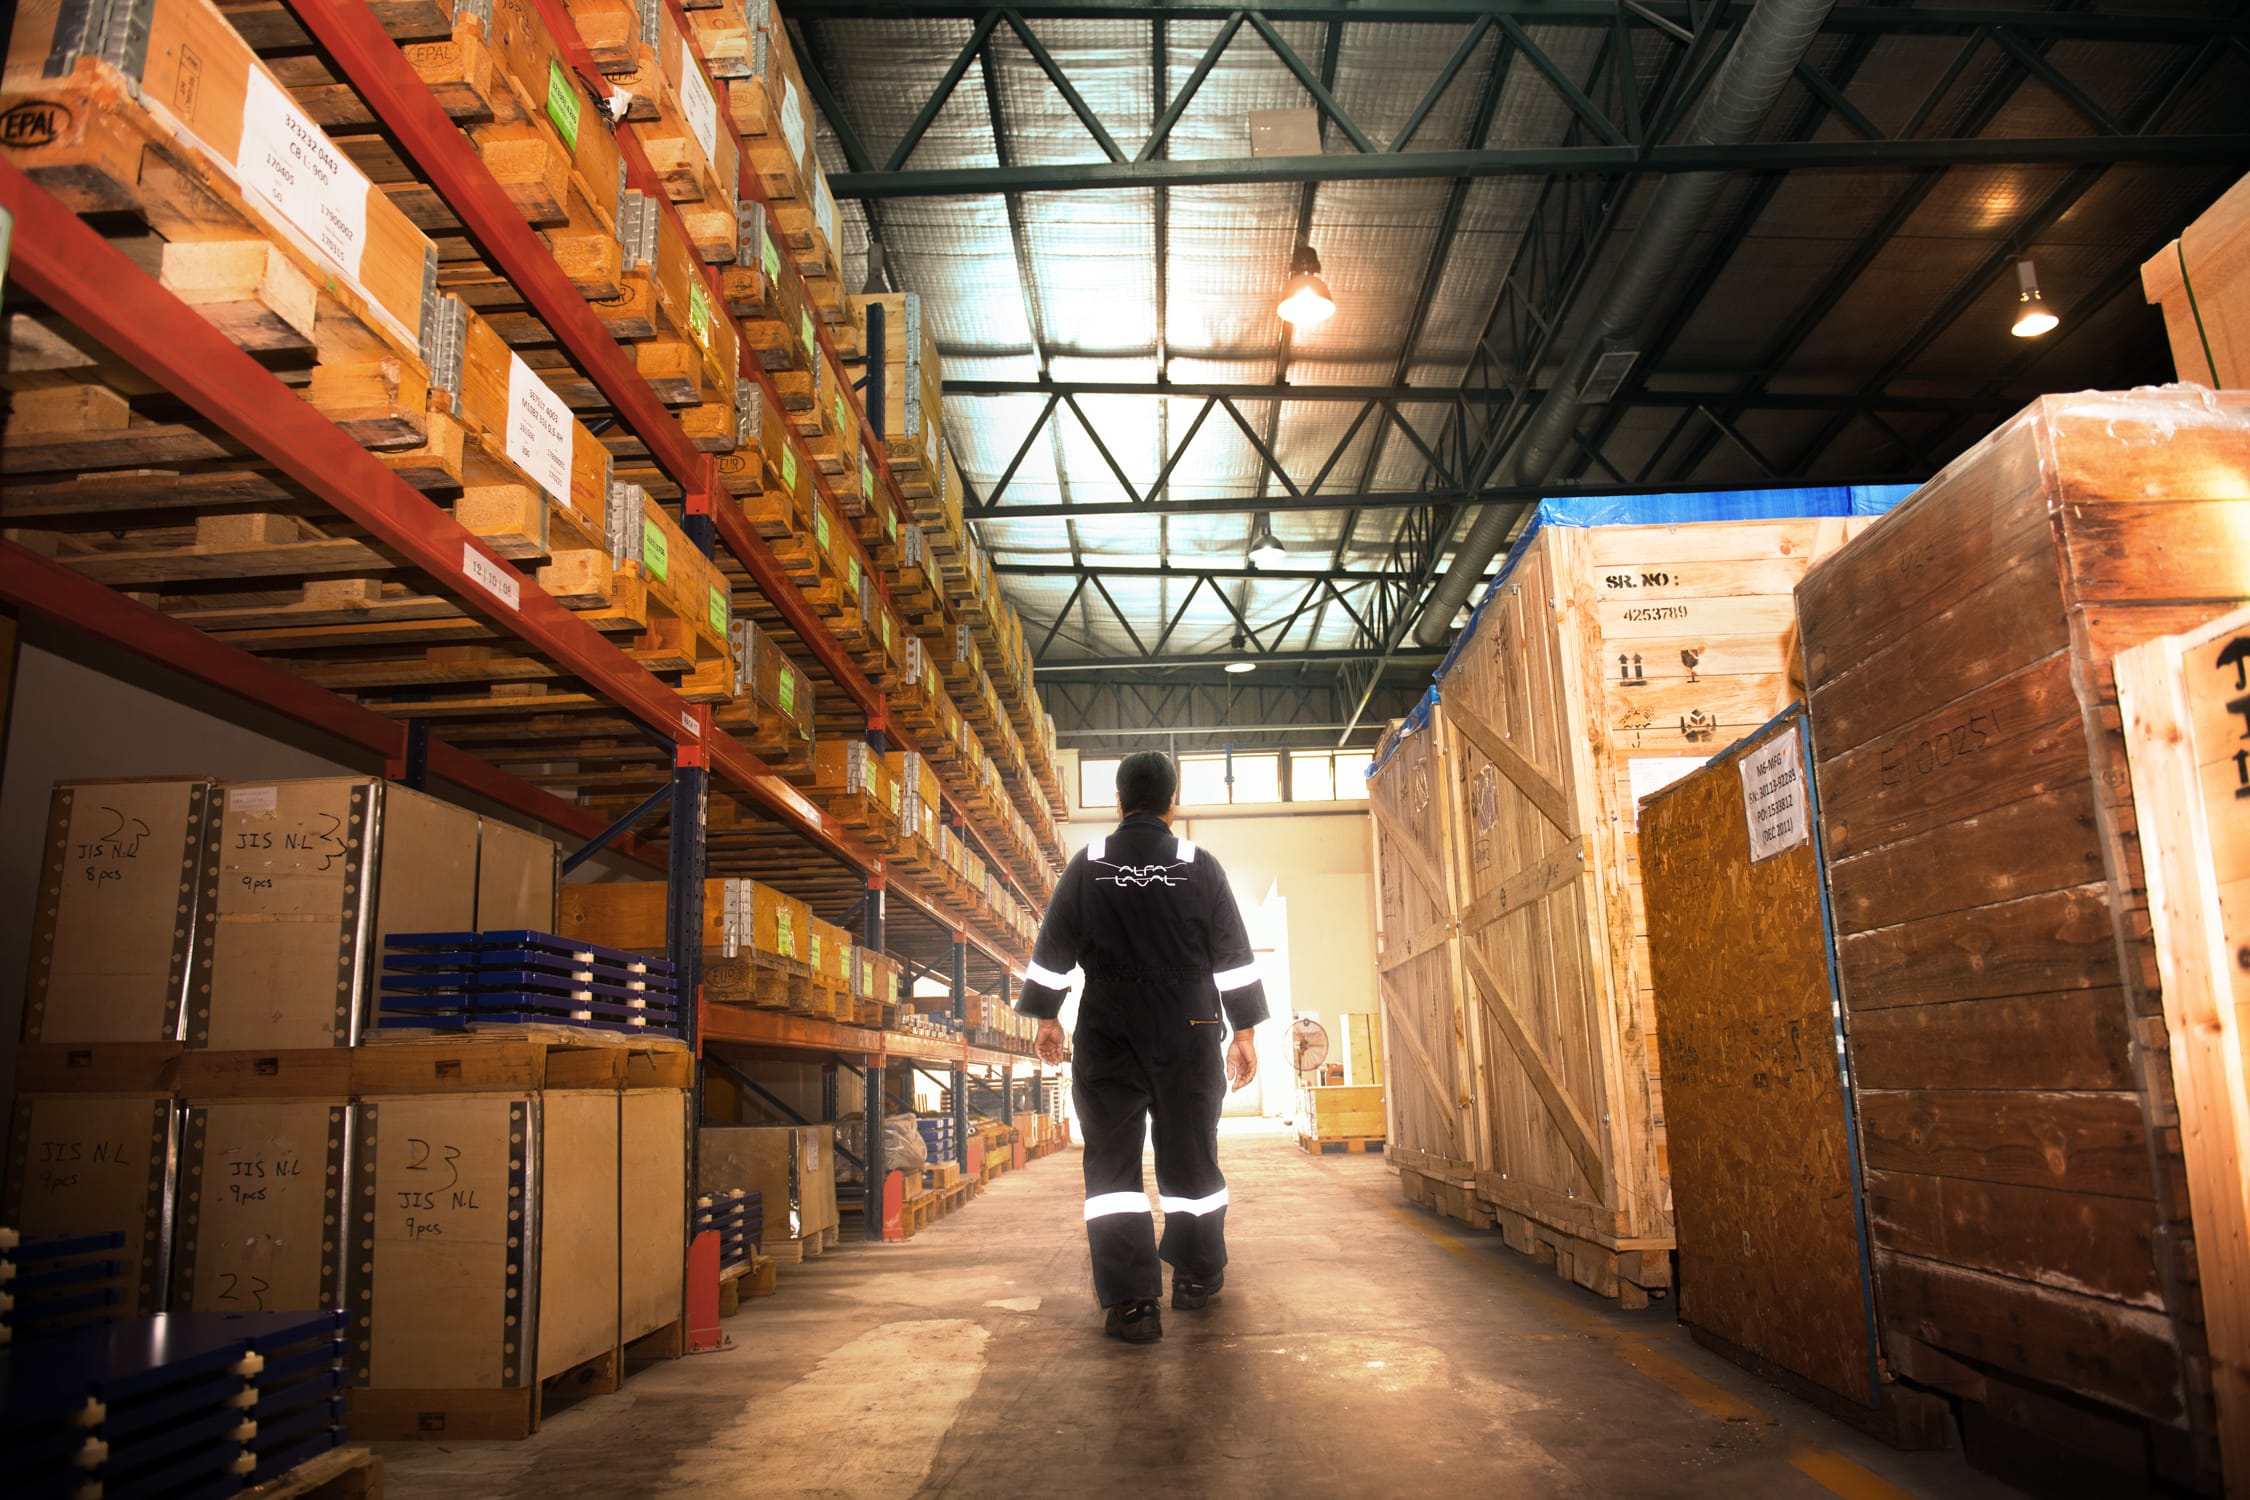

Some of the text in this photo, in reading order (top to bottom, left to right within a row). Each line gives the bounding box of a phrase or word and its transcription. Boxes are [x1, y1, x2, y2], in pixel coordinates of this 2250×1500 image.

[415, 46, 453, 61] EPAL
[5, 110, 58, 138] EPAL
[284, 113, 318, 152] 323232
[266, 152, 295, 186] 170405
[289, 141, 302, 161] CB
[312, 163, 330, 187] 900
[719, 458, 739, 470] EUR
[1605, 574, 1638, 589] SR.
[1623, 605, 1688, 622] 4253789
[1756, 752, 1782, 777] M6-MFG
[236, 832, 272, 849] JIS
[78, 844, 103, 859] JIS
[1119, 865, 1167, 877] ALFA
[1115, 875, 1176, 887] LAVAL
[40, 1142, 81, 1162] JIS
[229, 1161, 265, 1178] JIS
[398, 1192, 435, 1210] JIS
